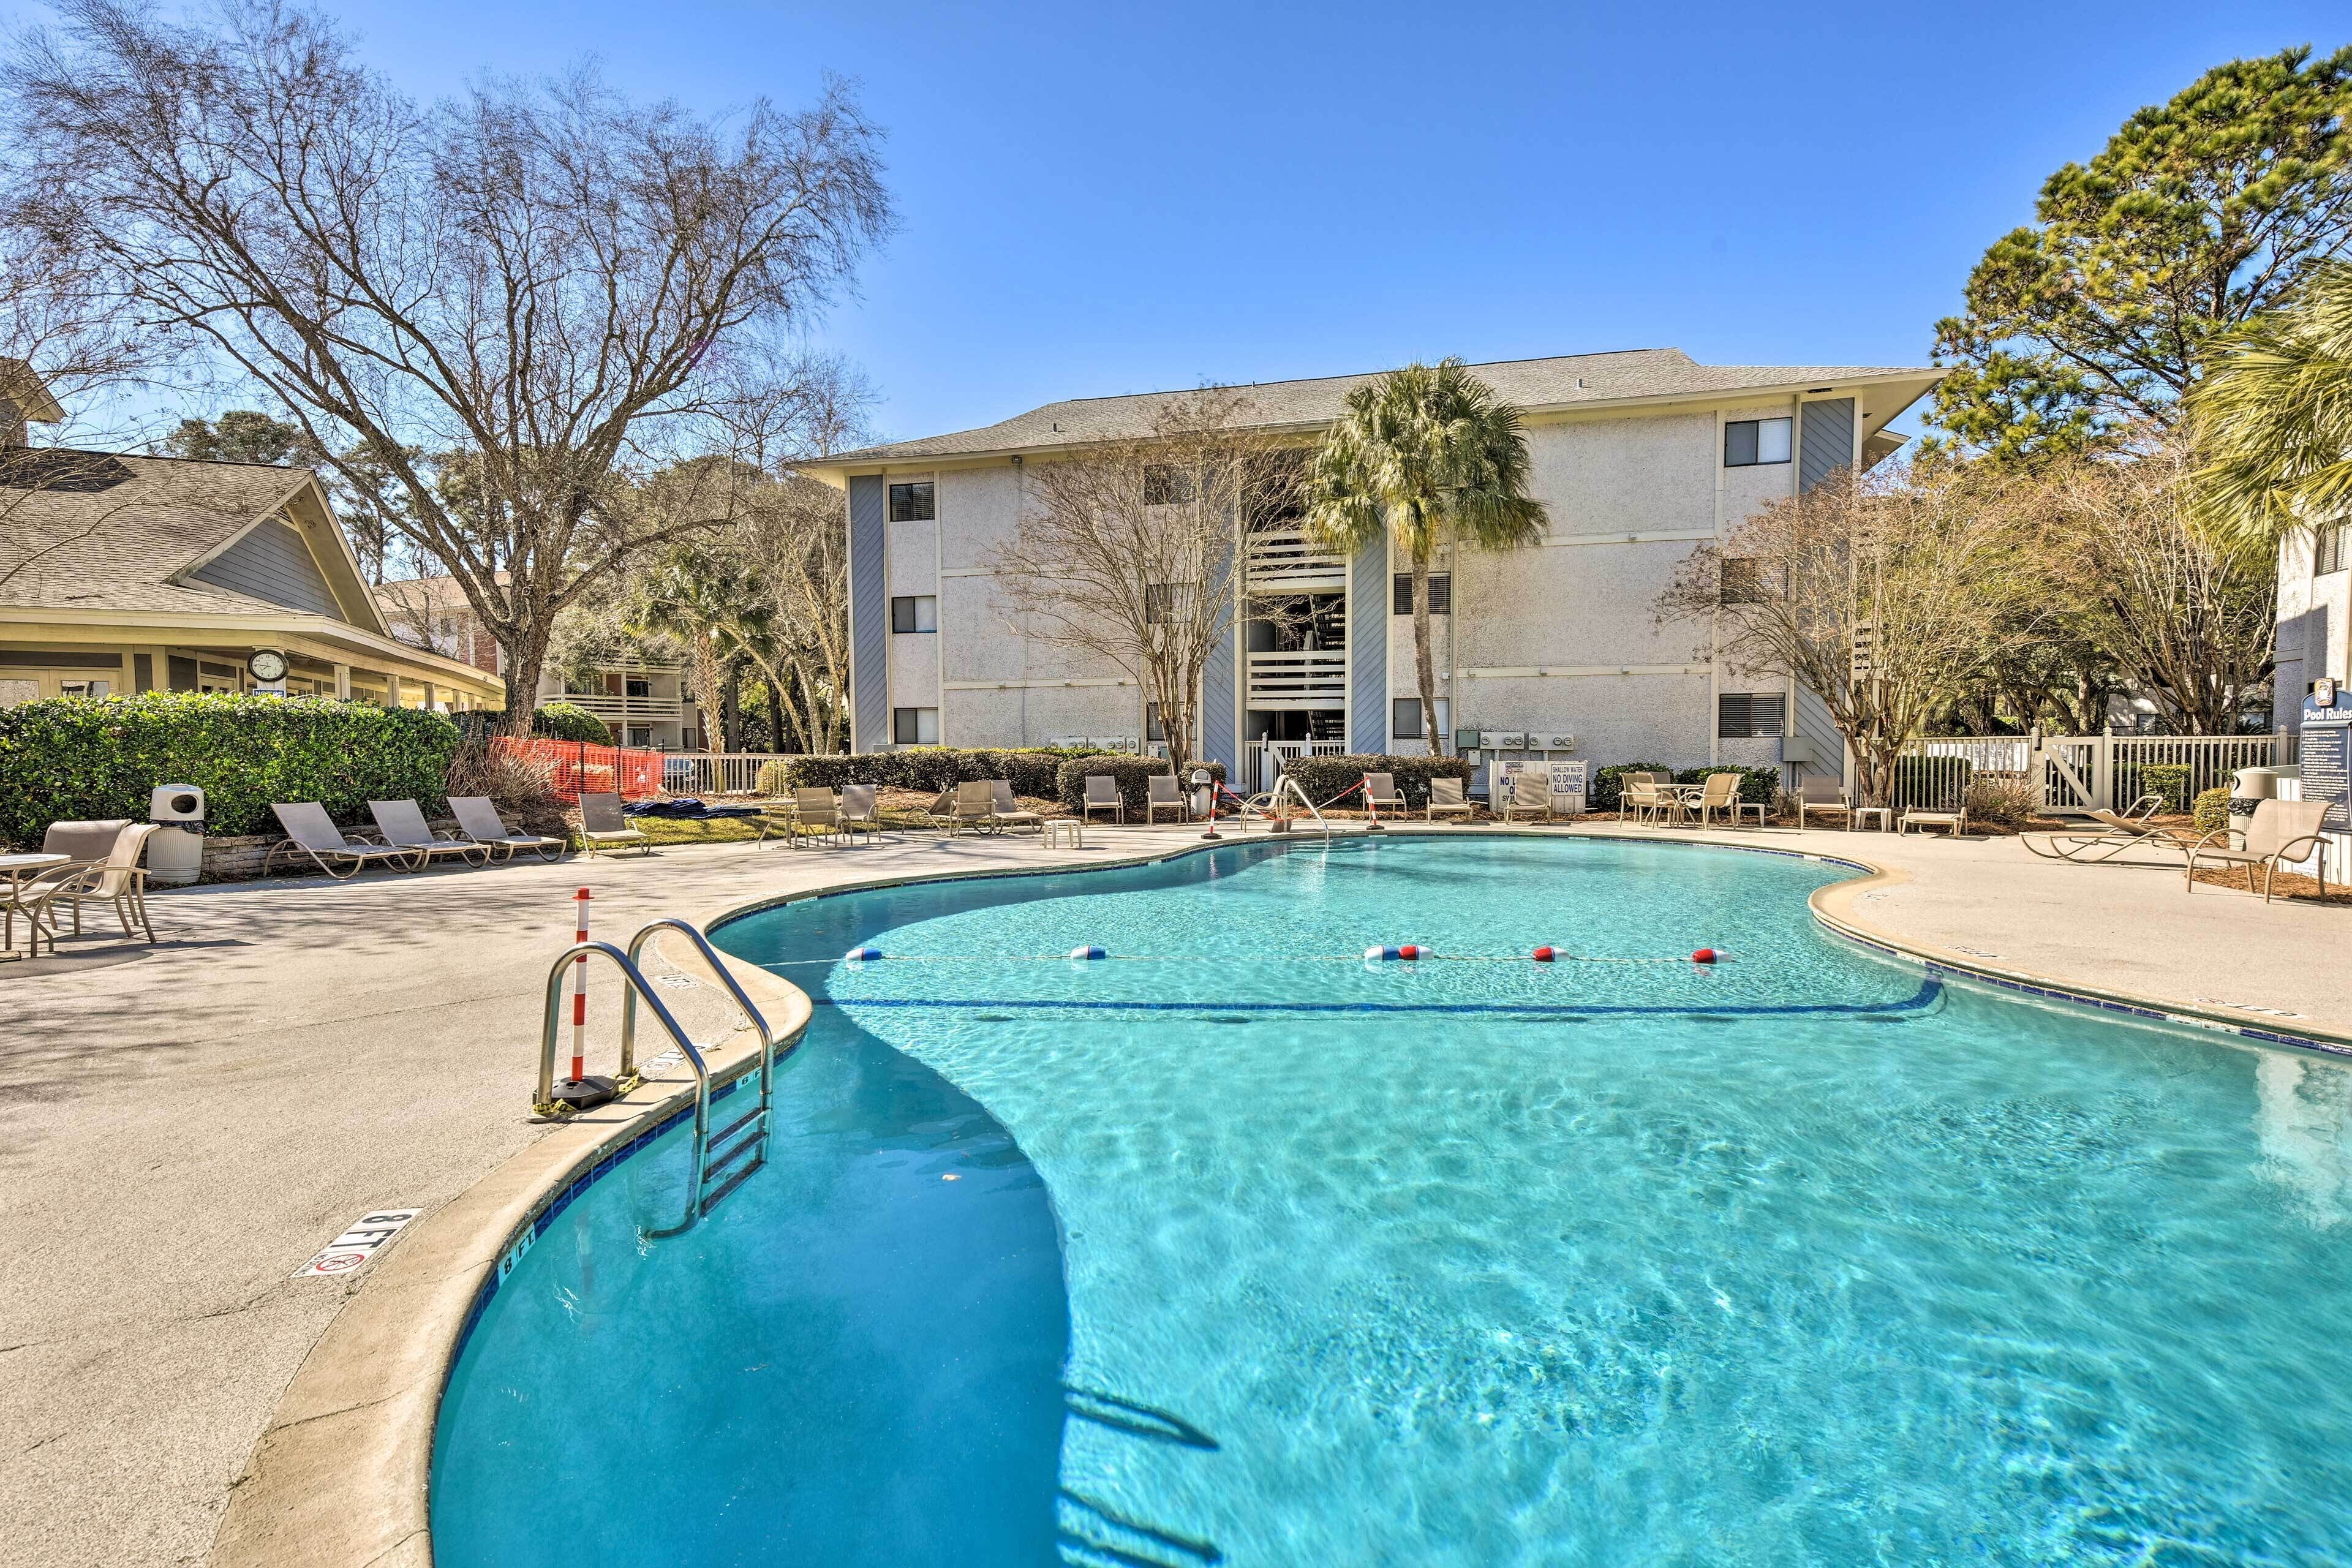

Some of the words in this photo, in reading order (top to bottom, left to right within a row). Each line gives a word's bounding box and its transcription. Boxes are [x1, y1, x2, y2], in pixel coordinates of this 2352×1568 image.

[2304, 708, 2324, 721] Pool
[2326, 707, 2352, 720] Rules
[1500, 777, 1509, 786] NO
[1553, 774, 1561, 783] NO
[1563, 774, 1583, 783] DIVING
[1553, 784, 1582, 793] ALLOWED
[741, 1076, 749, 1085] 6
[362, 1214, 412, 1224] 8
[330, 1229, 398, 1248] FT
[504, 1257, 513, 1275] 8
